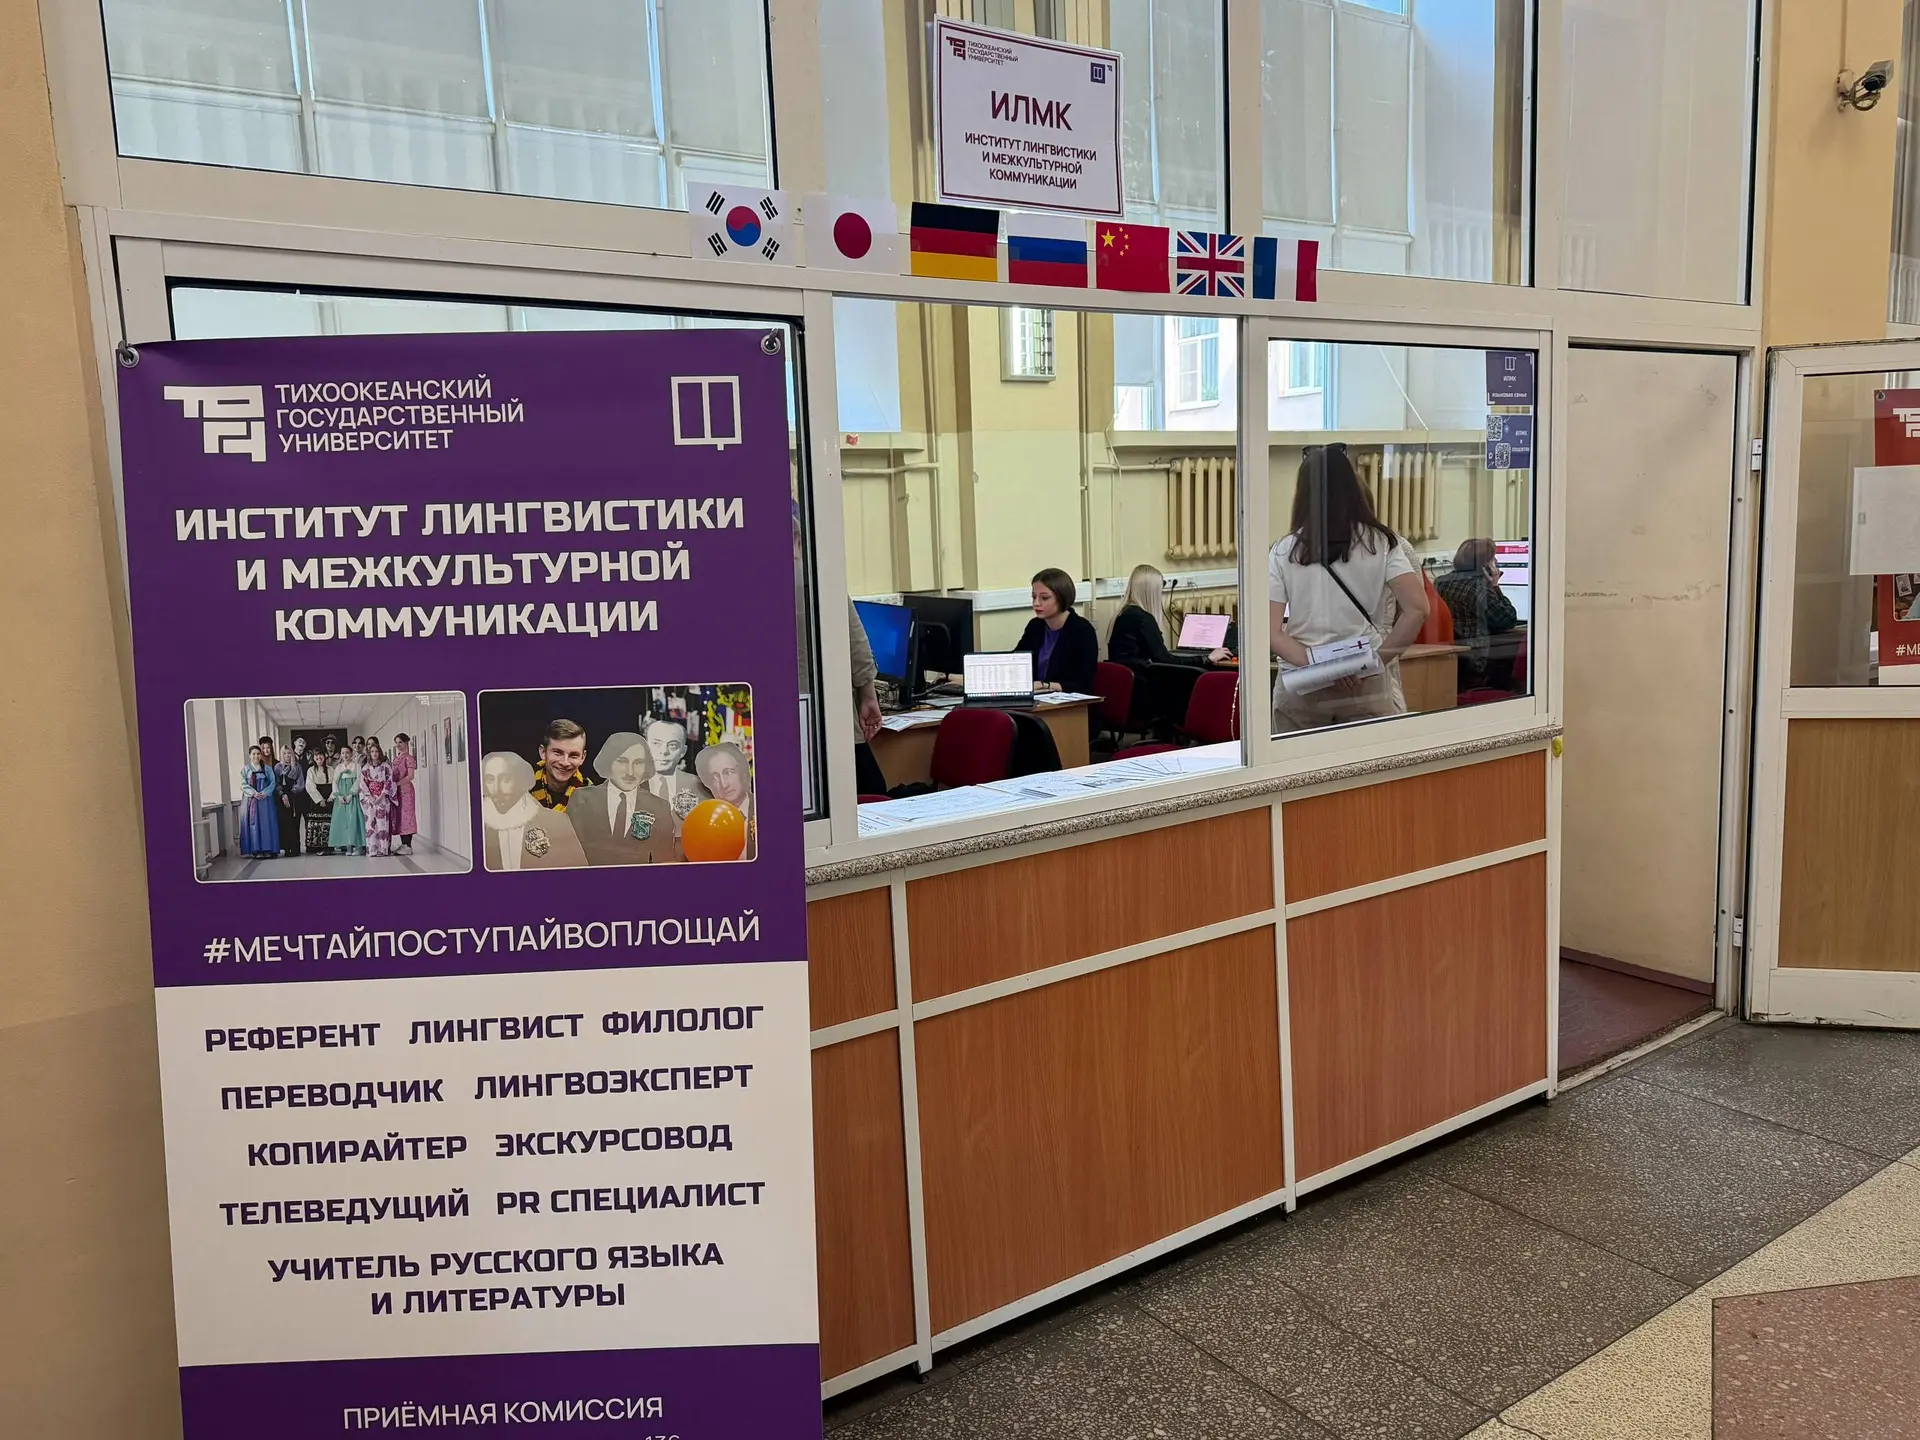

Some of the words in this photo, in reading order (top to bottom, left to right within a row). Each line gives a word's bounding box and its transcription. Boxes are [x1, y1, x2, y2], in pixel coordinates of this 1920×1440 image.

[968, 41, 1012, 54] ТИХООКЕАНСКИЙ
[968, 47, 1018, 63] ГОСУДАРСТВЕННЫЙ
[968, 54, 1004, 66] УНИВЕРСИТЕТ
[991, 90, 1073, 131] ИЛМК
[965, 132, 1021, 150] ИНСТИТУТ
[1023, 141, 1096, 161] ЛИНГВИСТИКИ
[982, 151, 990, 163] И
[992, 153, 1082, 174] МЕЖКУЛЬТУРНОЙ
[990, 168, 1076, 189] КОММУНИКАЦИИ
[275, 374, 491, 403] ТИХООКЕАНСКИЙ
[277, 398, 523, 429] ГОСУДАРСТВЕННЫЙ
[279, 430, 453, 452] УНИВЕРСИТЕТ
[176, 505, 407, 540] ИНСТИТУТ
[422, 498, 743, 535] ЛИНГВИСТИКИ
[237, 560, 266, 590] И
[283, 541, 689, 589] МЕЖКУЛЬТУРНОЙ
[276, 601, 657, 640] КОММУНИКАЦИИ
[204, 910, 759, 963] #МЕЧТАЙПОСТУПАЙВОПЛОЩАЙ
[206, 1023, 380, 1052] РЕФЕРЕНТ
[409, 1014, 583, 1044] ЛИНГВИСТ
[603, 1006, 763, 1035] ФИЛОЛОГ
[222, 1079, 443, 1109] ПЕРЕВОДЧИК
[475, 1065, 753, 1099] ЛИНГВОЭКСПЕРТ
[248, 1136, 466, 1166] КОПИРАЙТЕР
[496, 1125, 732, 1156] ЭКСКУРСОВОД
[220, 1188, 469, 1225] ТЕЛЕВЕДУЩИЙ
[497, 1192, 540, 1214] PR
[551, 1182, 765, 1213] СПЕЦИАЛИСТ
[268, 1255, 419, 1282] УЧИТЕЛЬ
[431, 1248, 597, 1276] РУССКОГО
[608, 1243, 724, 1269] ЯЗЫКА
[372, 1293, 392, 1314] И
[403, 1284, 624, 1313] ЛИТЕРАТУРЫ
[344, 1401, 496, 1429] ПРИЁМНАЯ
[505, 1397, 662, 1423] КОМИССИЯ
